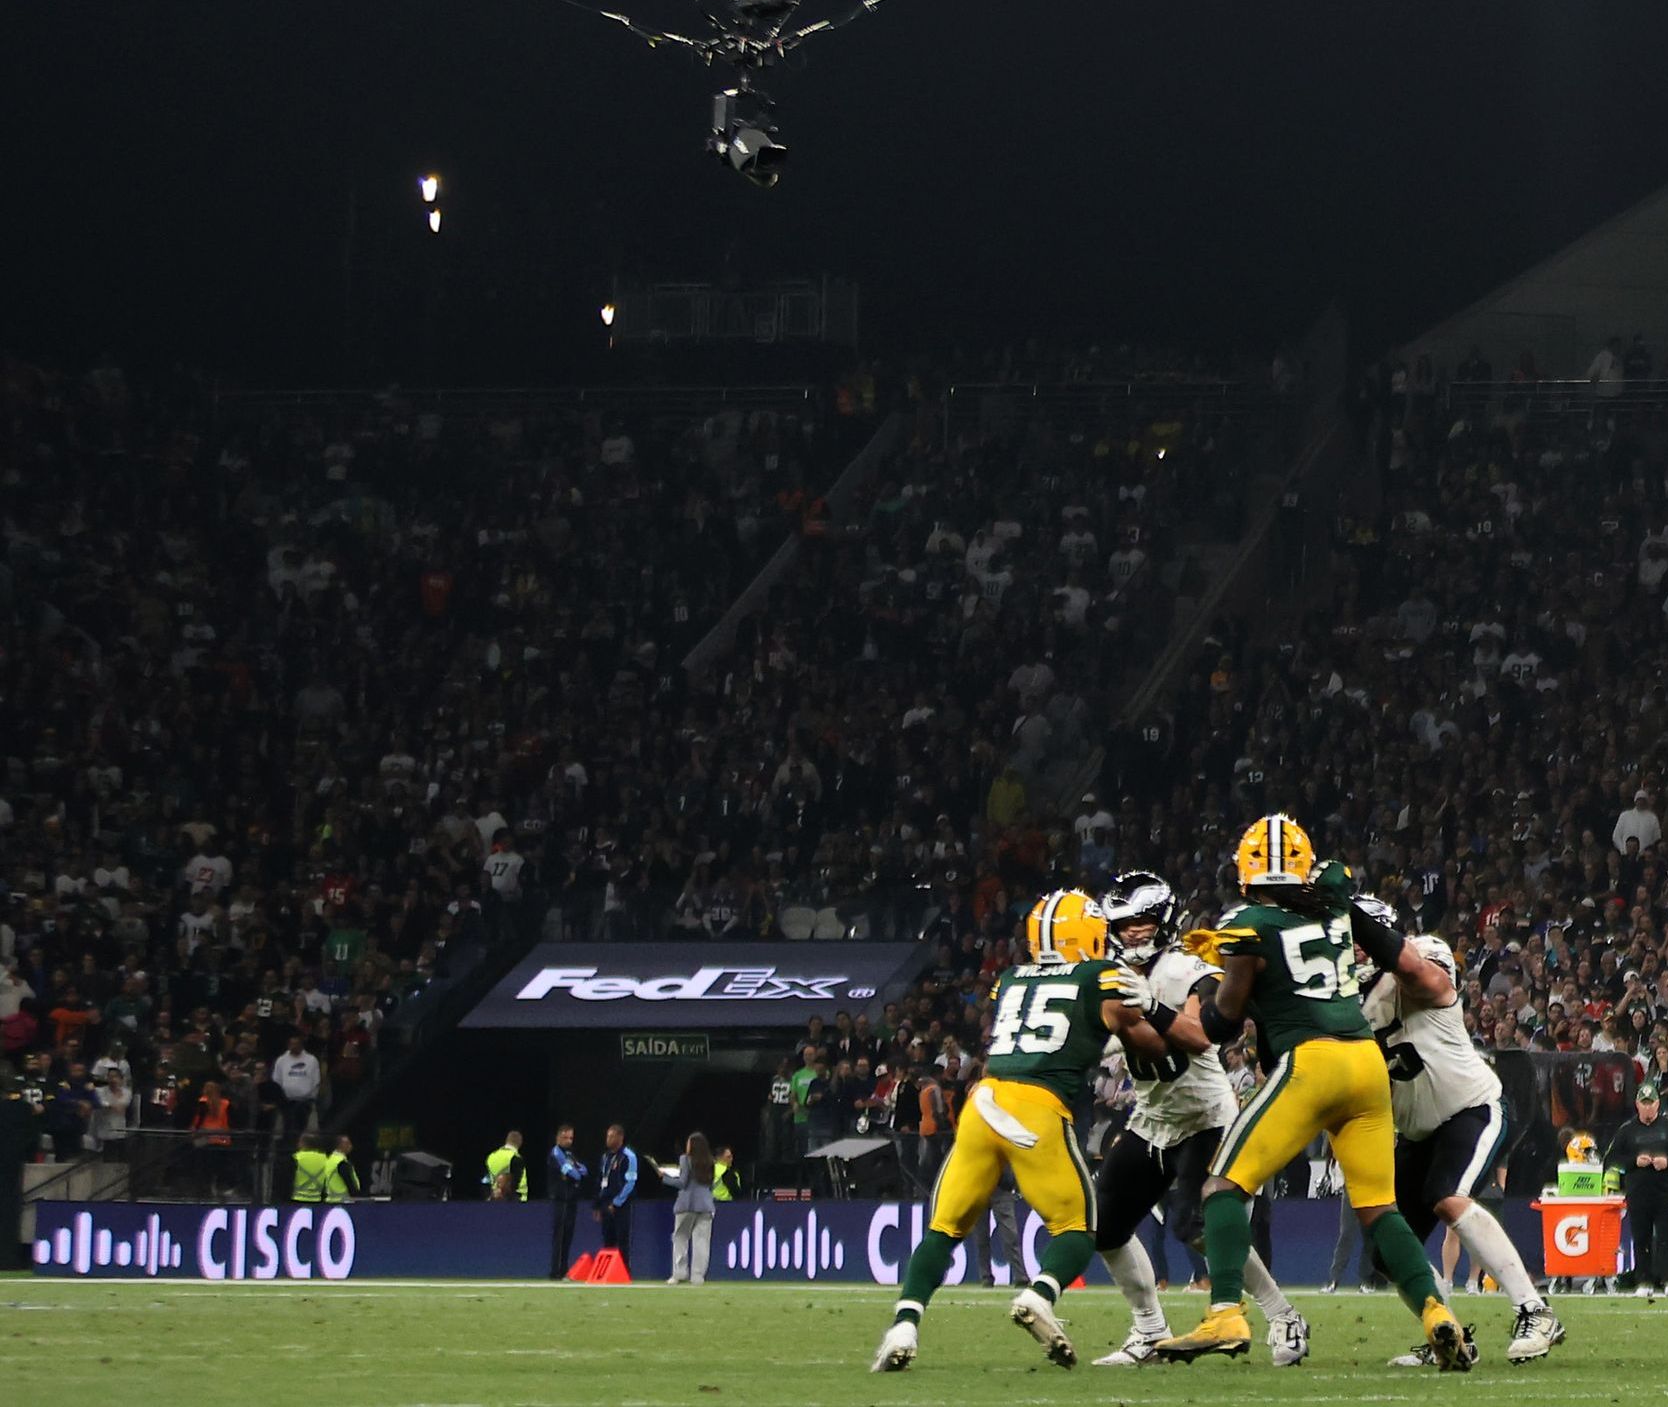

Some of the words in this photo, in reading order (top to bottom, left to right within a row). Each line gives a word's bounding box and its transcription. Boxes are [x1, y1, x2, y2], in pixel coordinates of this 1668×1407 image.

[515, 967, 850, 1001] FedEx
[988, 984, 1080, 1057] 45
[624, 1039, 679, 1057] SAÍDA
[200, 1205, 355, 1280] CISCO
[1554, 1216, 1588, 1256] G
